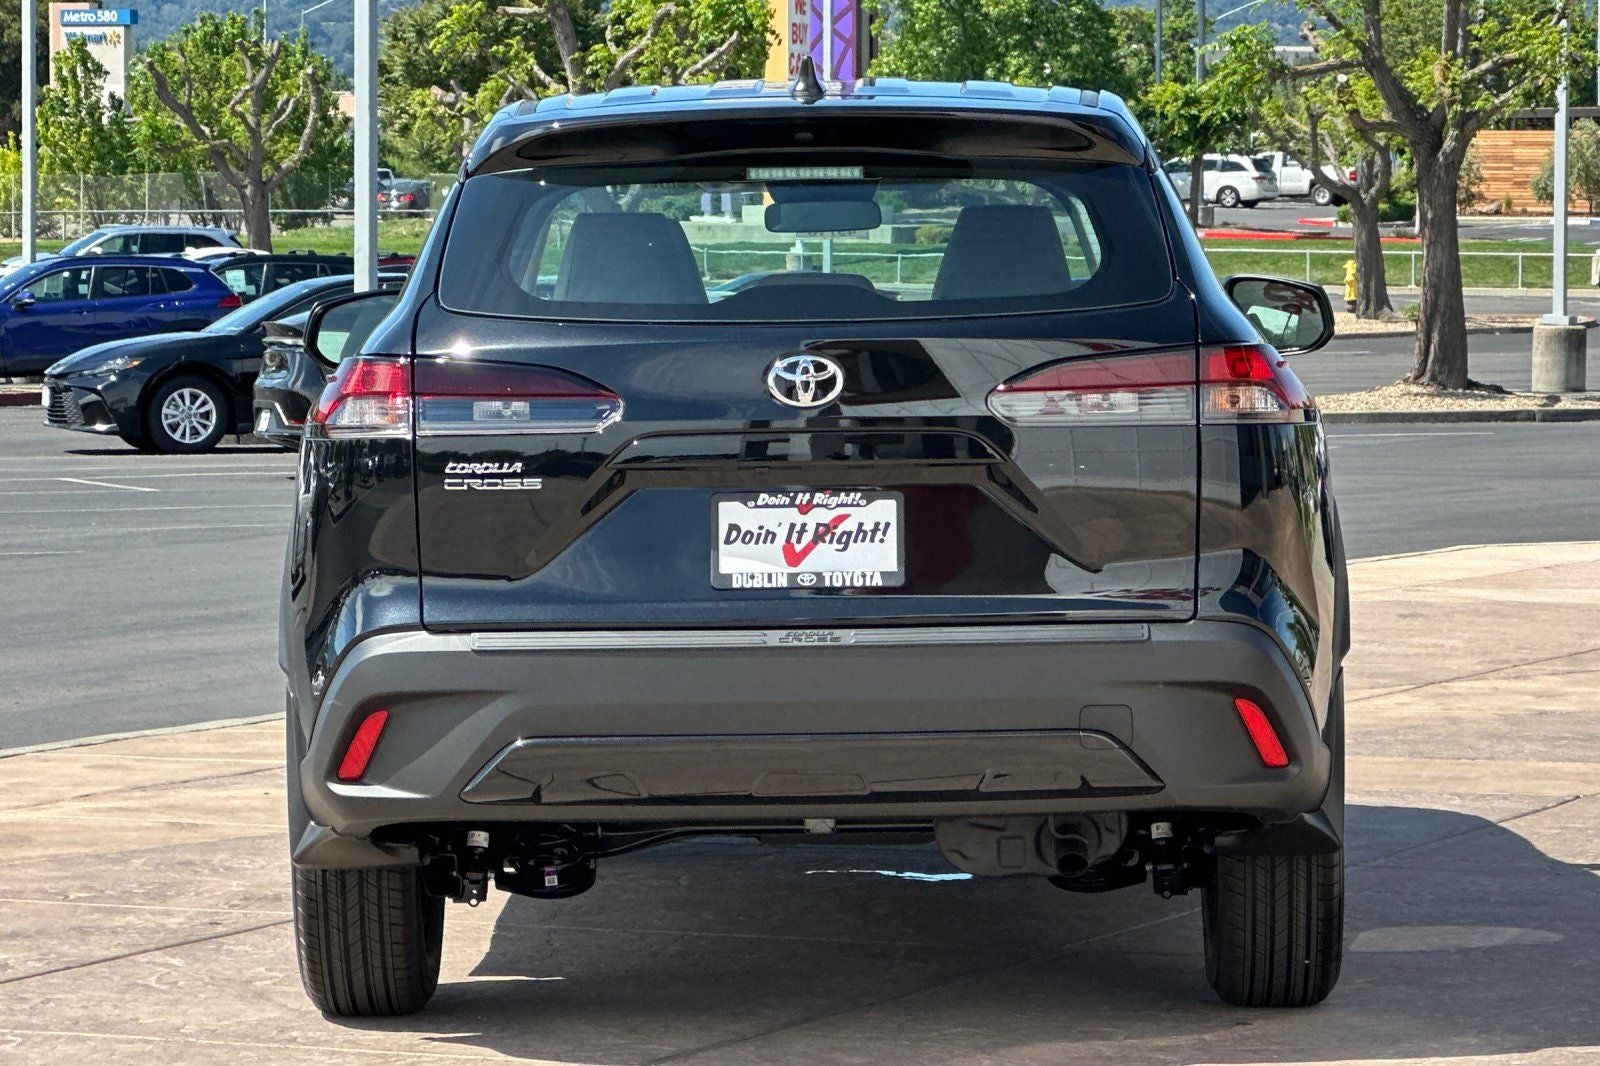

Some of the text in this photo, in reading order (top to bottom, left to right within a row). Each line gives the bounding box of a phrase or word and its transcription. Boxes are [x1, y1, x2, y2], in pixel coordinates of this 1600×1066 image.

[63, 10, 118, 23] Metro 580
[791, 22, 808, 45] BUY
[444, 461, 523, 475] COROLLA
[443, 478, 543, 491] CROSS
[756, 492, 862, 509] Doin' It Right!
[723, 521, 892, 552] Doin' It Right!
[732, 571, 883, 588] DUBLIN TOYOTA
